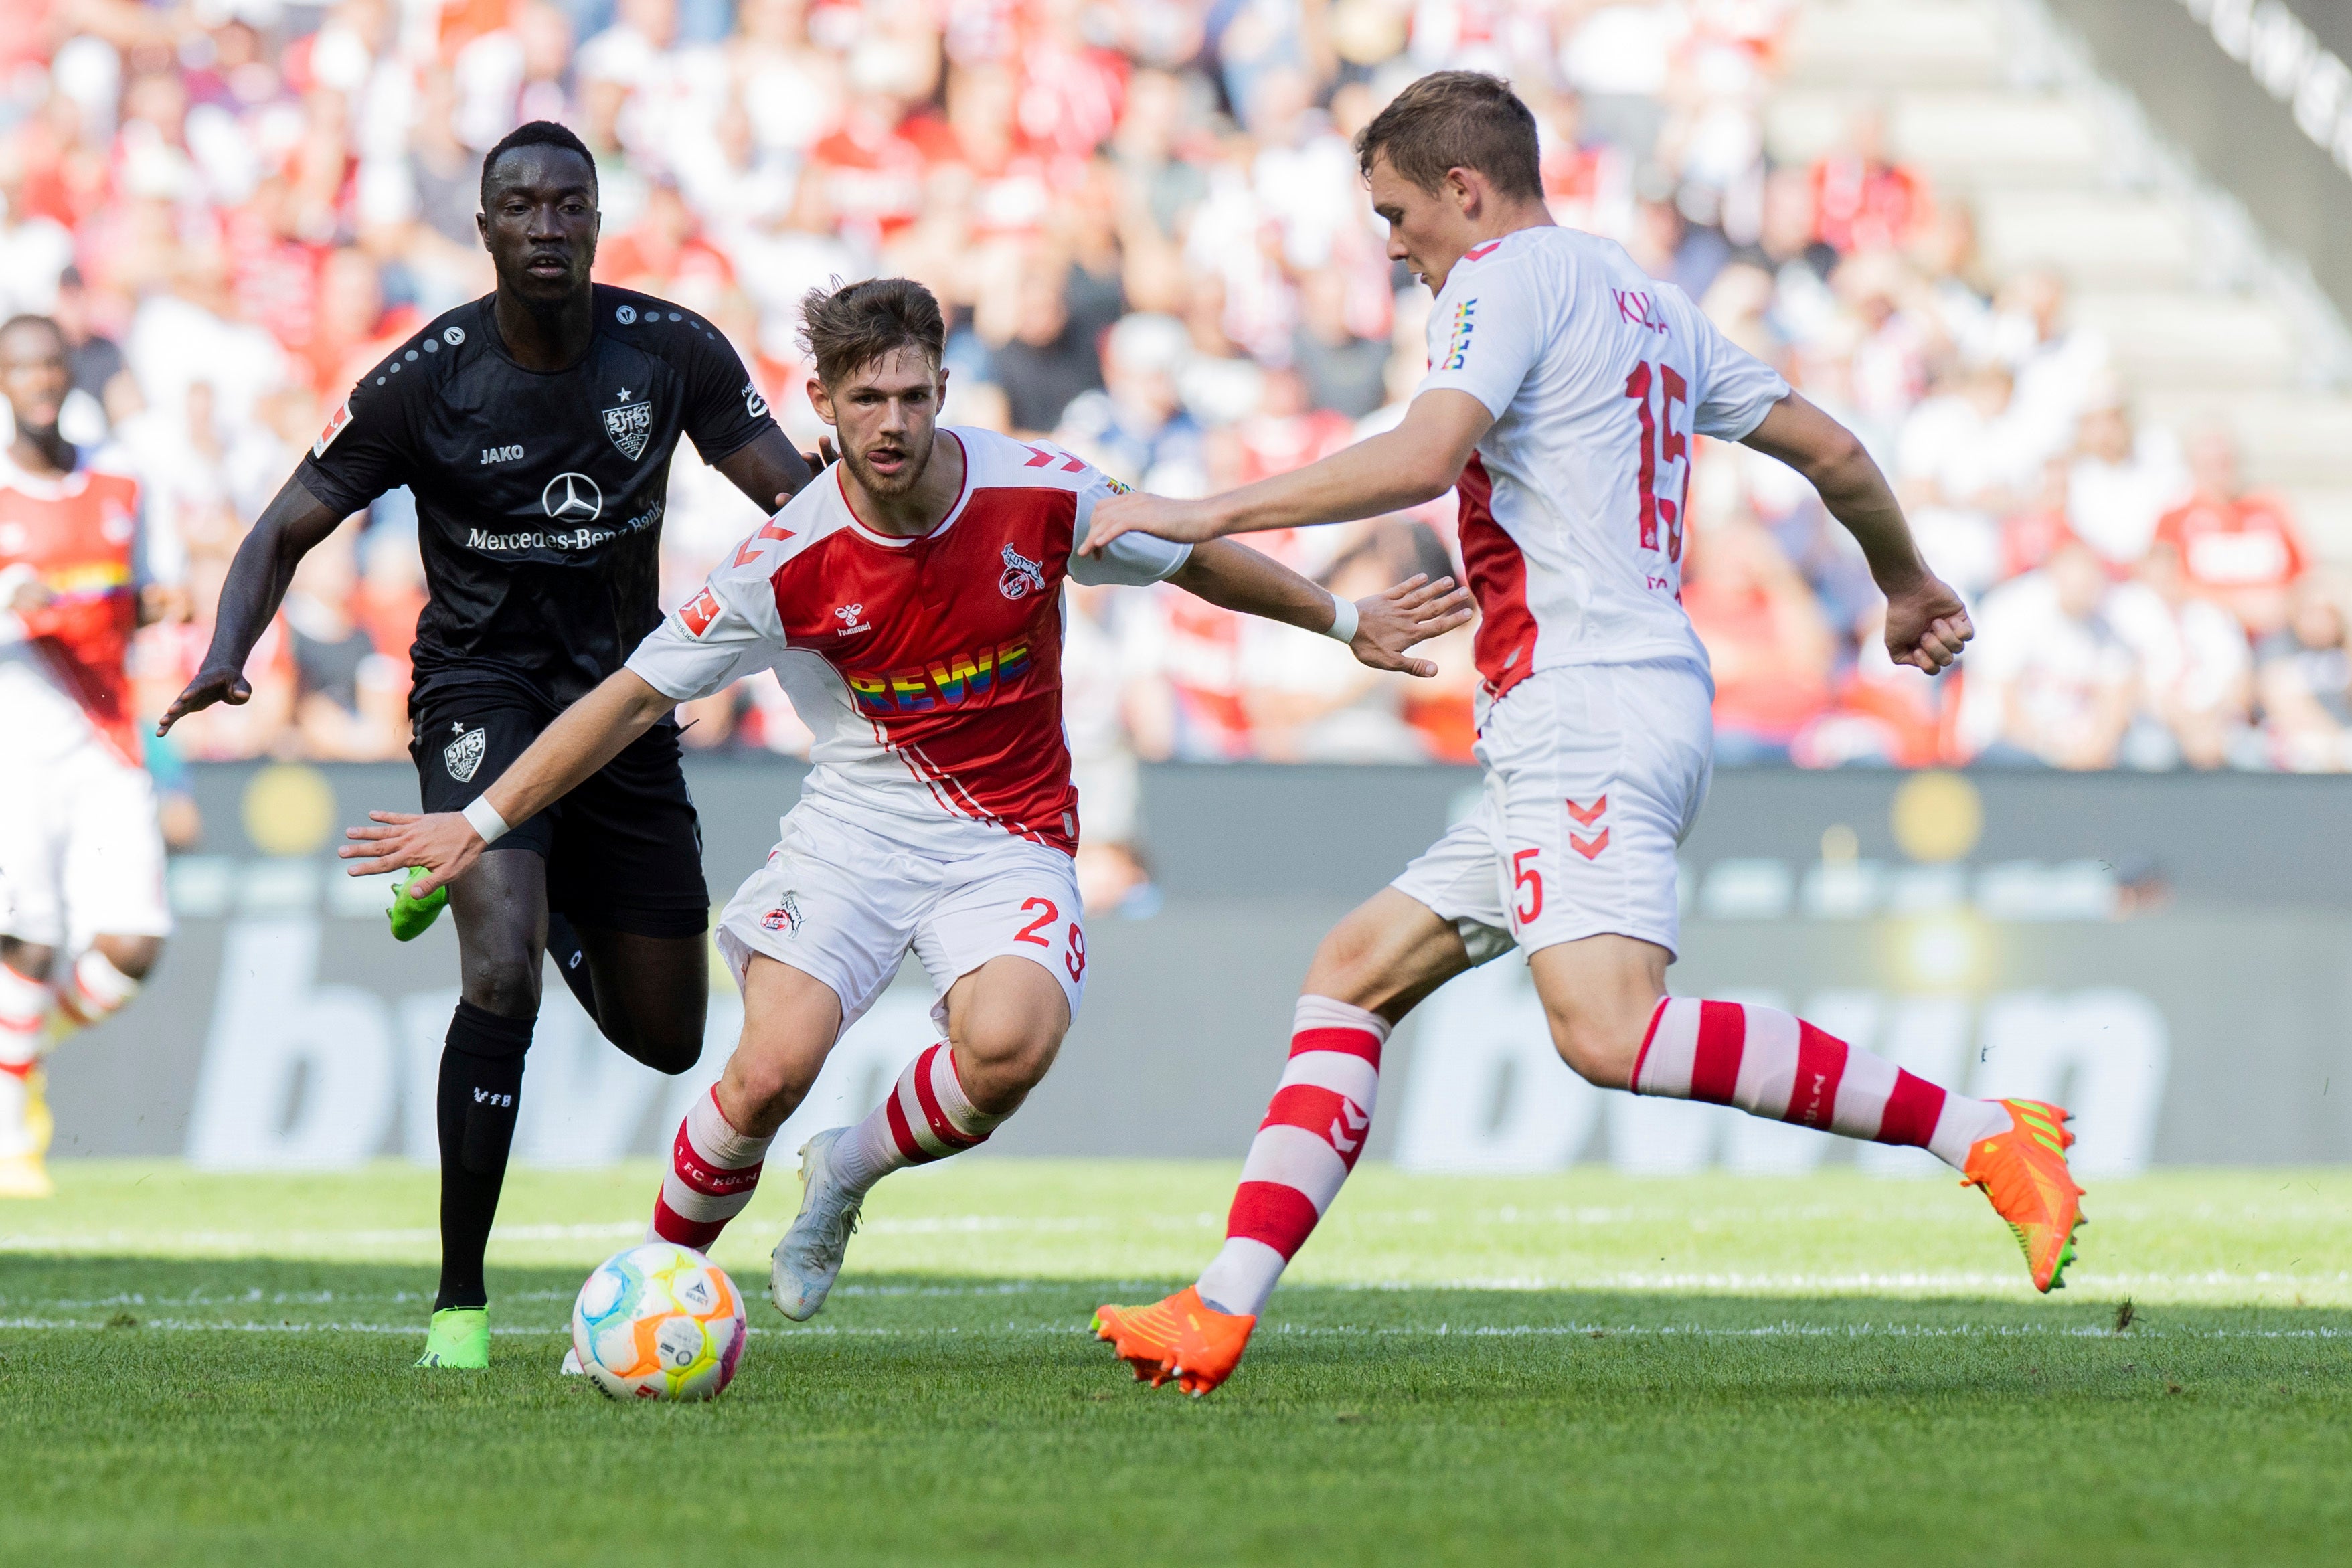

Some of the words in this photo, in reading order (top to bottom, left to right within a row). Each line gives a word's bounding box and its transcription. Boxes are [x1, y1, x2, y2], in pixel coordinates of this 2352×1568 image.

[1441, 298, 1477, 371] DEVK
[481, 444, 524, 464] JAKO
[1625, 359, 1691, 563] 15
[628, 499, 663, 532] Bank
[837, 621, 871, 637] hummel
[847, 636, 1031, 711] REWE
[1509, 848, 1542, 928] 5
[1013, 897, 1086, 984] 29
[473, 1087, 512, 1108] VfB
